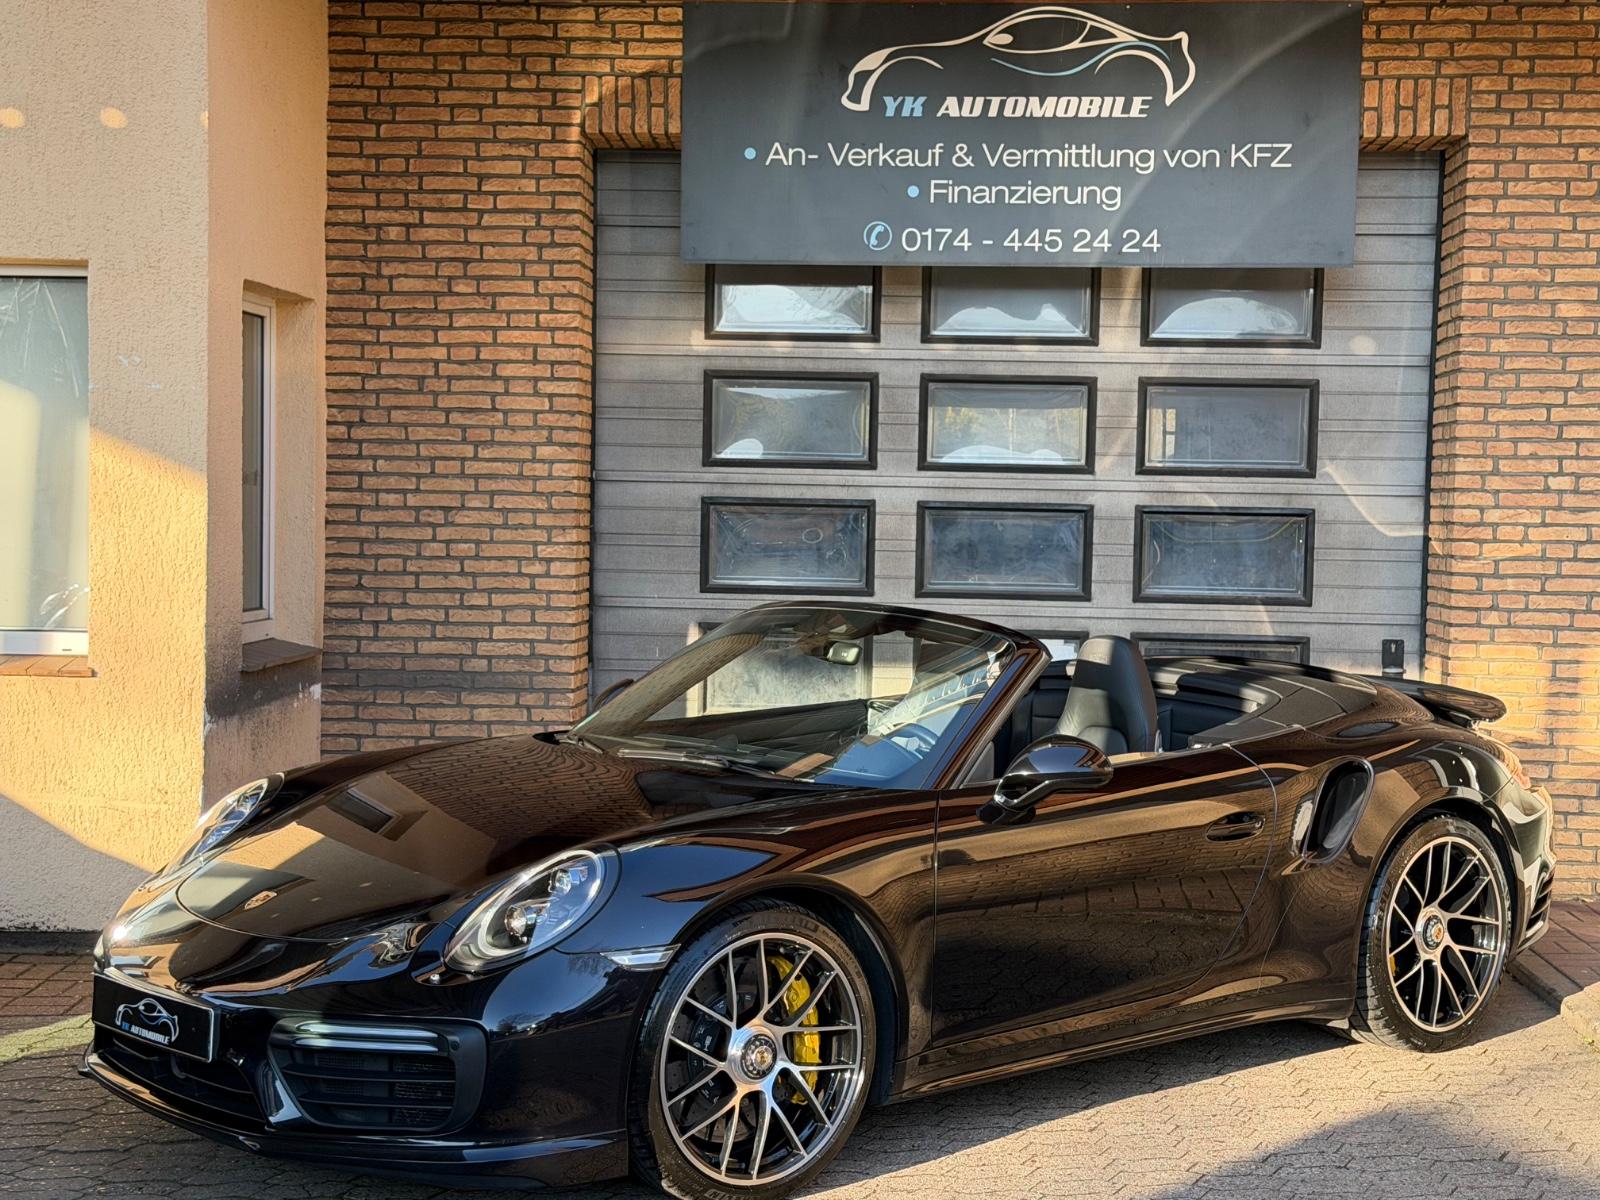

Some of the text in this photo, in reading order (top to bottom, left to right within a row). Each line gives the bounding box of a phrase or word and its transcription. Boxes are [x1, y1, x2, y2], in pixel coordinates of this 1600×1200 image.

[883, 96, 1152, 118] YK AUTOMOBILE
[765, 142, 1293, 174] An- Verkauf & Vermittlung von KFZ
[929, 180, 1122, 210] Finanzierung
[901, 228, 971, 253] 0174
[1002, 228, 1063, 253] 445
[1072, 228, 1112, 253] 24
[1121, 228, 1162, 253] 24
